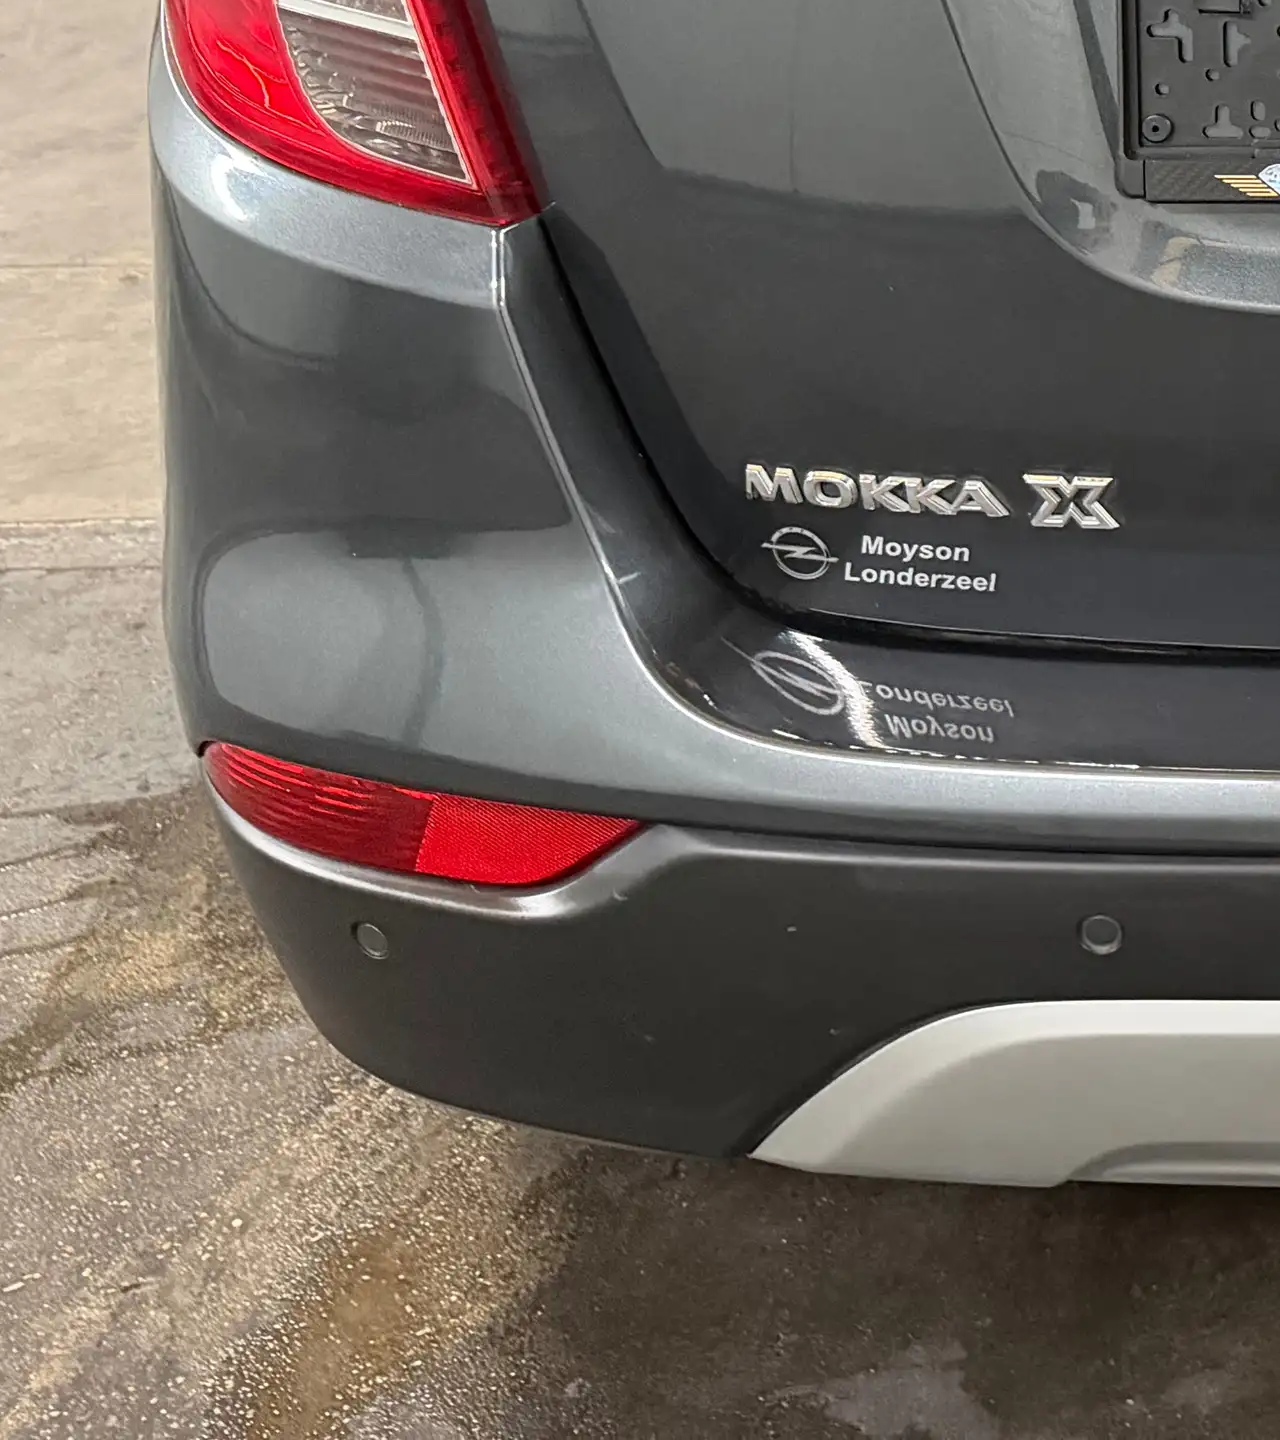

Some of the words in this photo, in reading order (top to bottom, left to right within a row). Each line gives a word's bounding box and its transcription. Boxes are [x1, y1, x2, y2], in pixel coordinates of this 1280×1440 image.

[745, 463, 1011, 517] MOKKA
[1022, 473, 1121, 529] X
[861, 534, 971, 562] Moyson
[844, 562, 997, 592] Londerzeel
